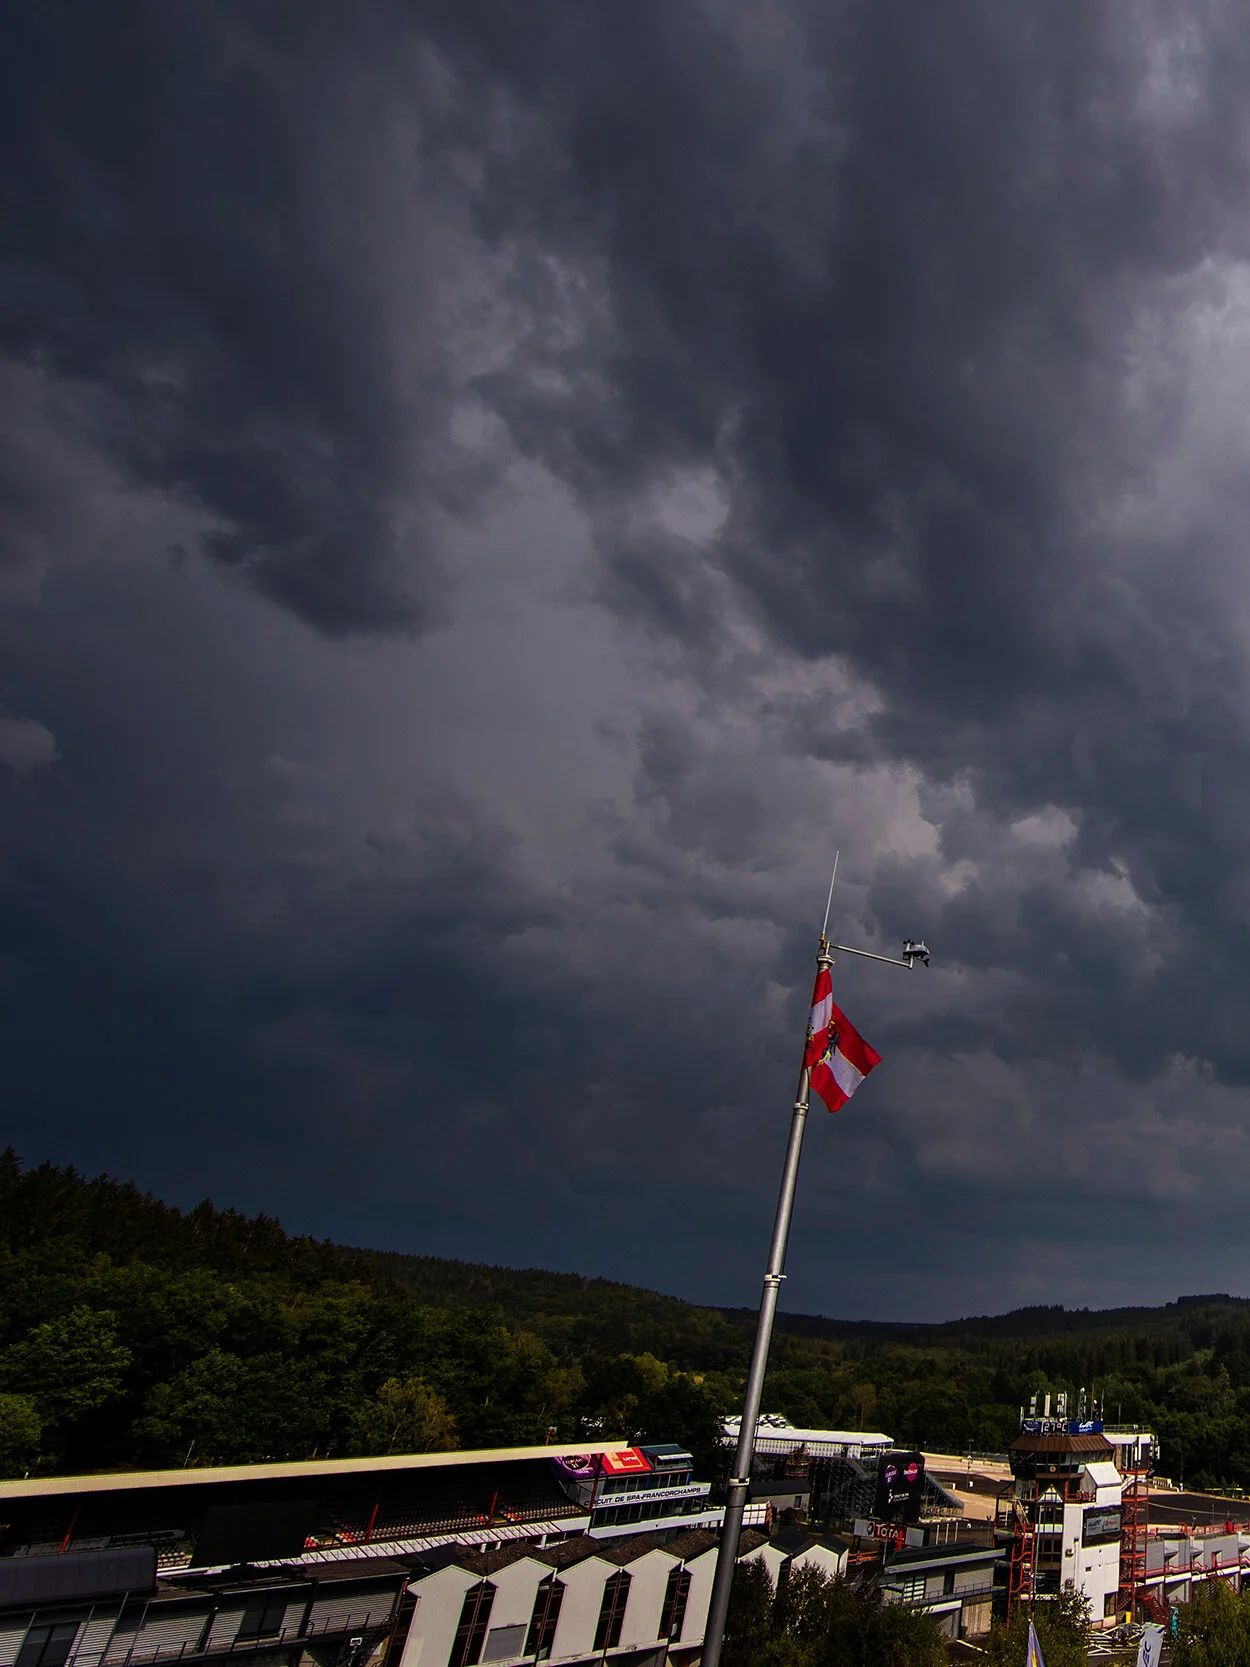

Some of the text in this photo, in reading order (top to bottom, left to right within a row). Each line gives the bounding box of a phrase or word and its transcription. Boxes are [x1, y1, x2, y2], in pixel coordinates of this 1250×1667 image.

[583, 1497, 613, 1506] CRCUIT
[626, 1487, 701, 1501] SPA-FRANCORCHAMPS
[876, 1523, 905, 1541] TOTA
